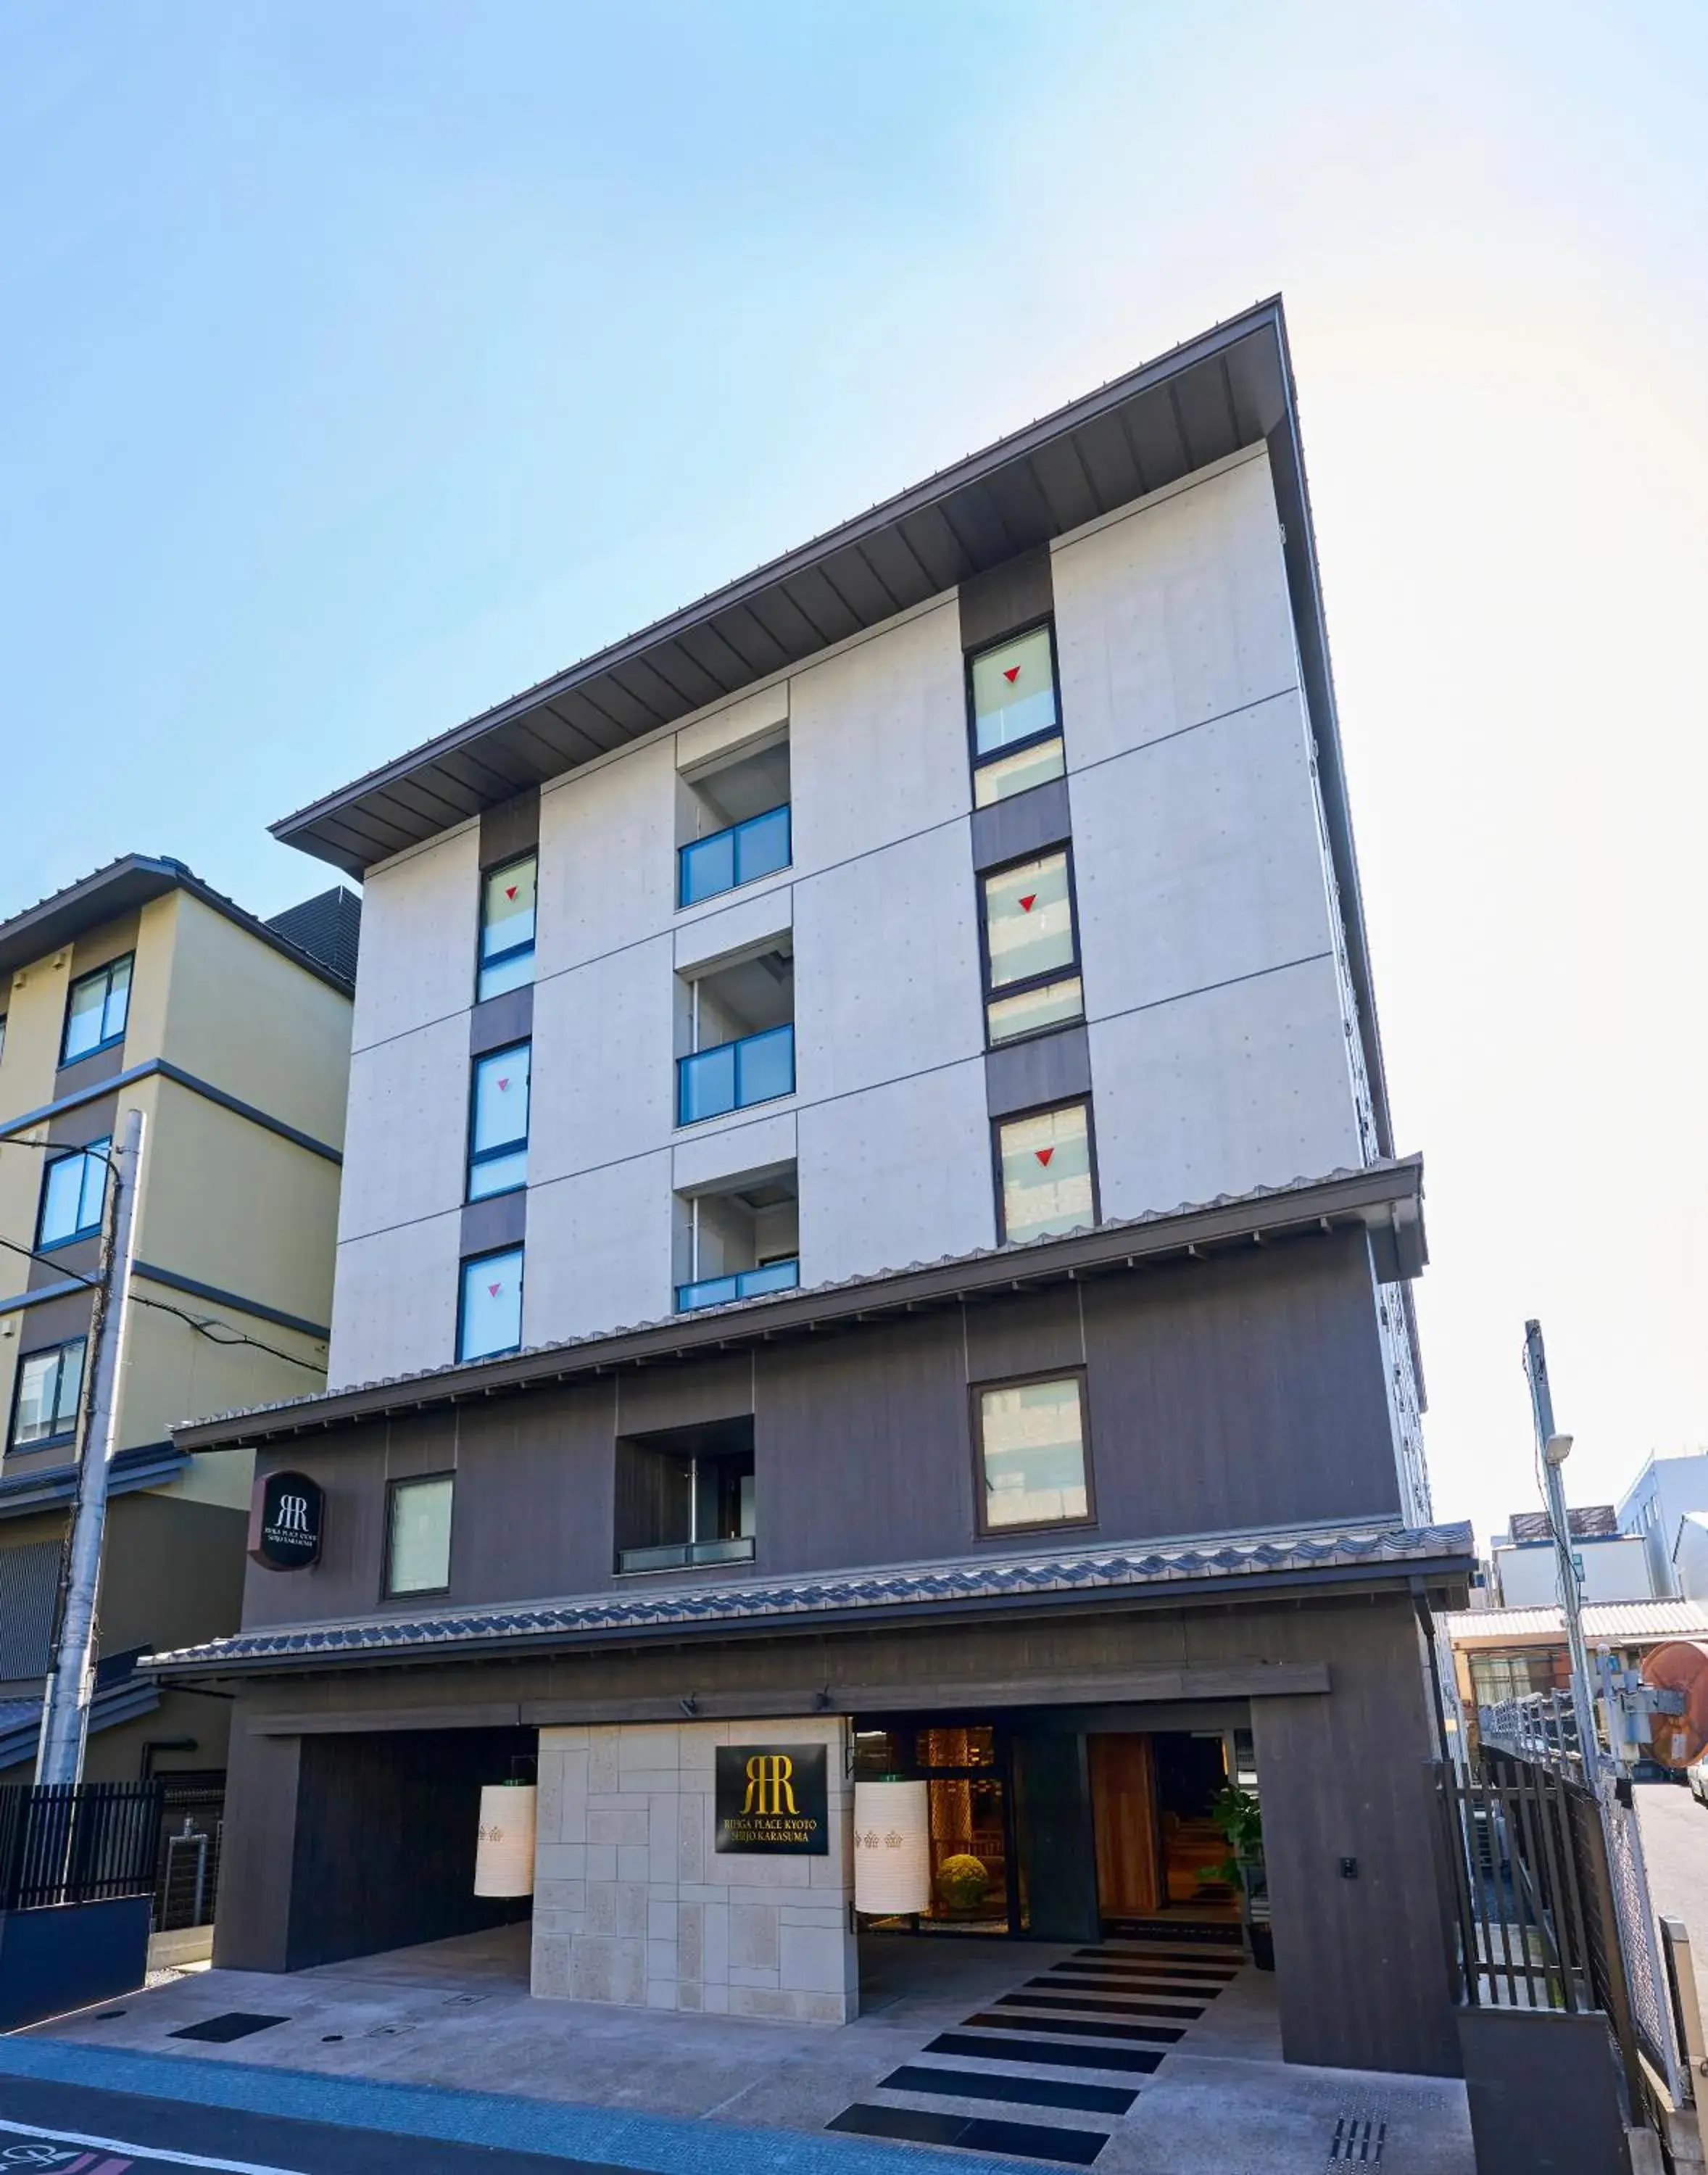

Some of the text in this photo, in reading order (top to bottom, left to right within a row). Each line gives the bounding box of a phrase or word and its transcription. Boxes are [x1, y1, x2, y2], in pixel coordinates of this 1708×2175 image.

[755, 1819, 782, 1829] PLACE
[784, 1819, 816, 1830] KYOTO
[758, 1831, 809, 1842] KARASUMA
